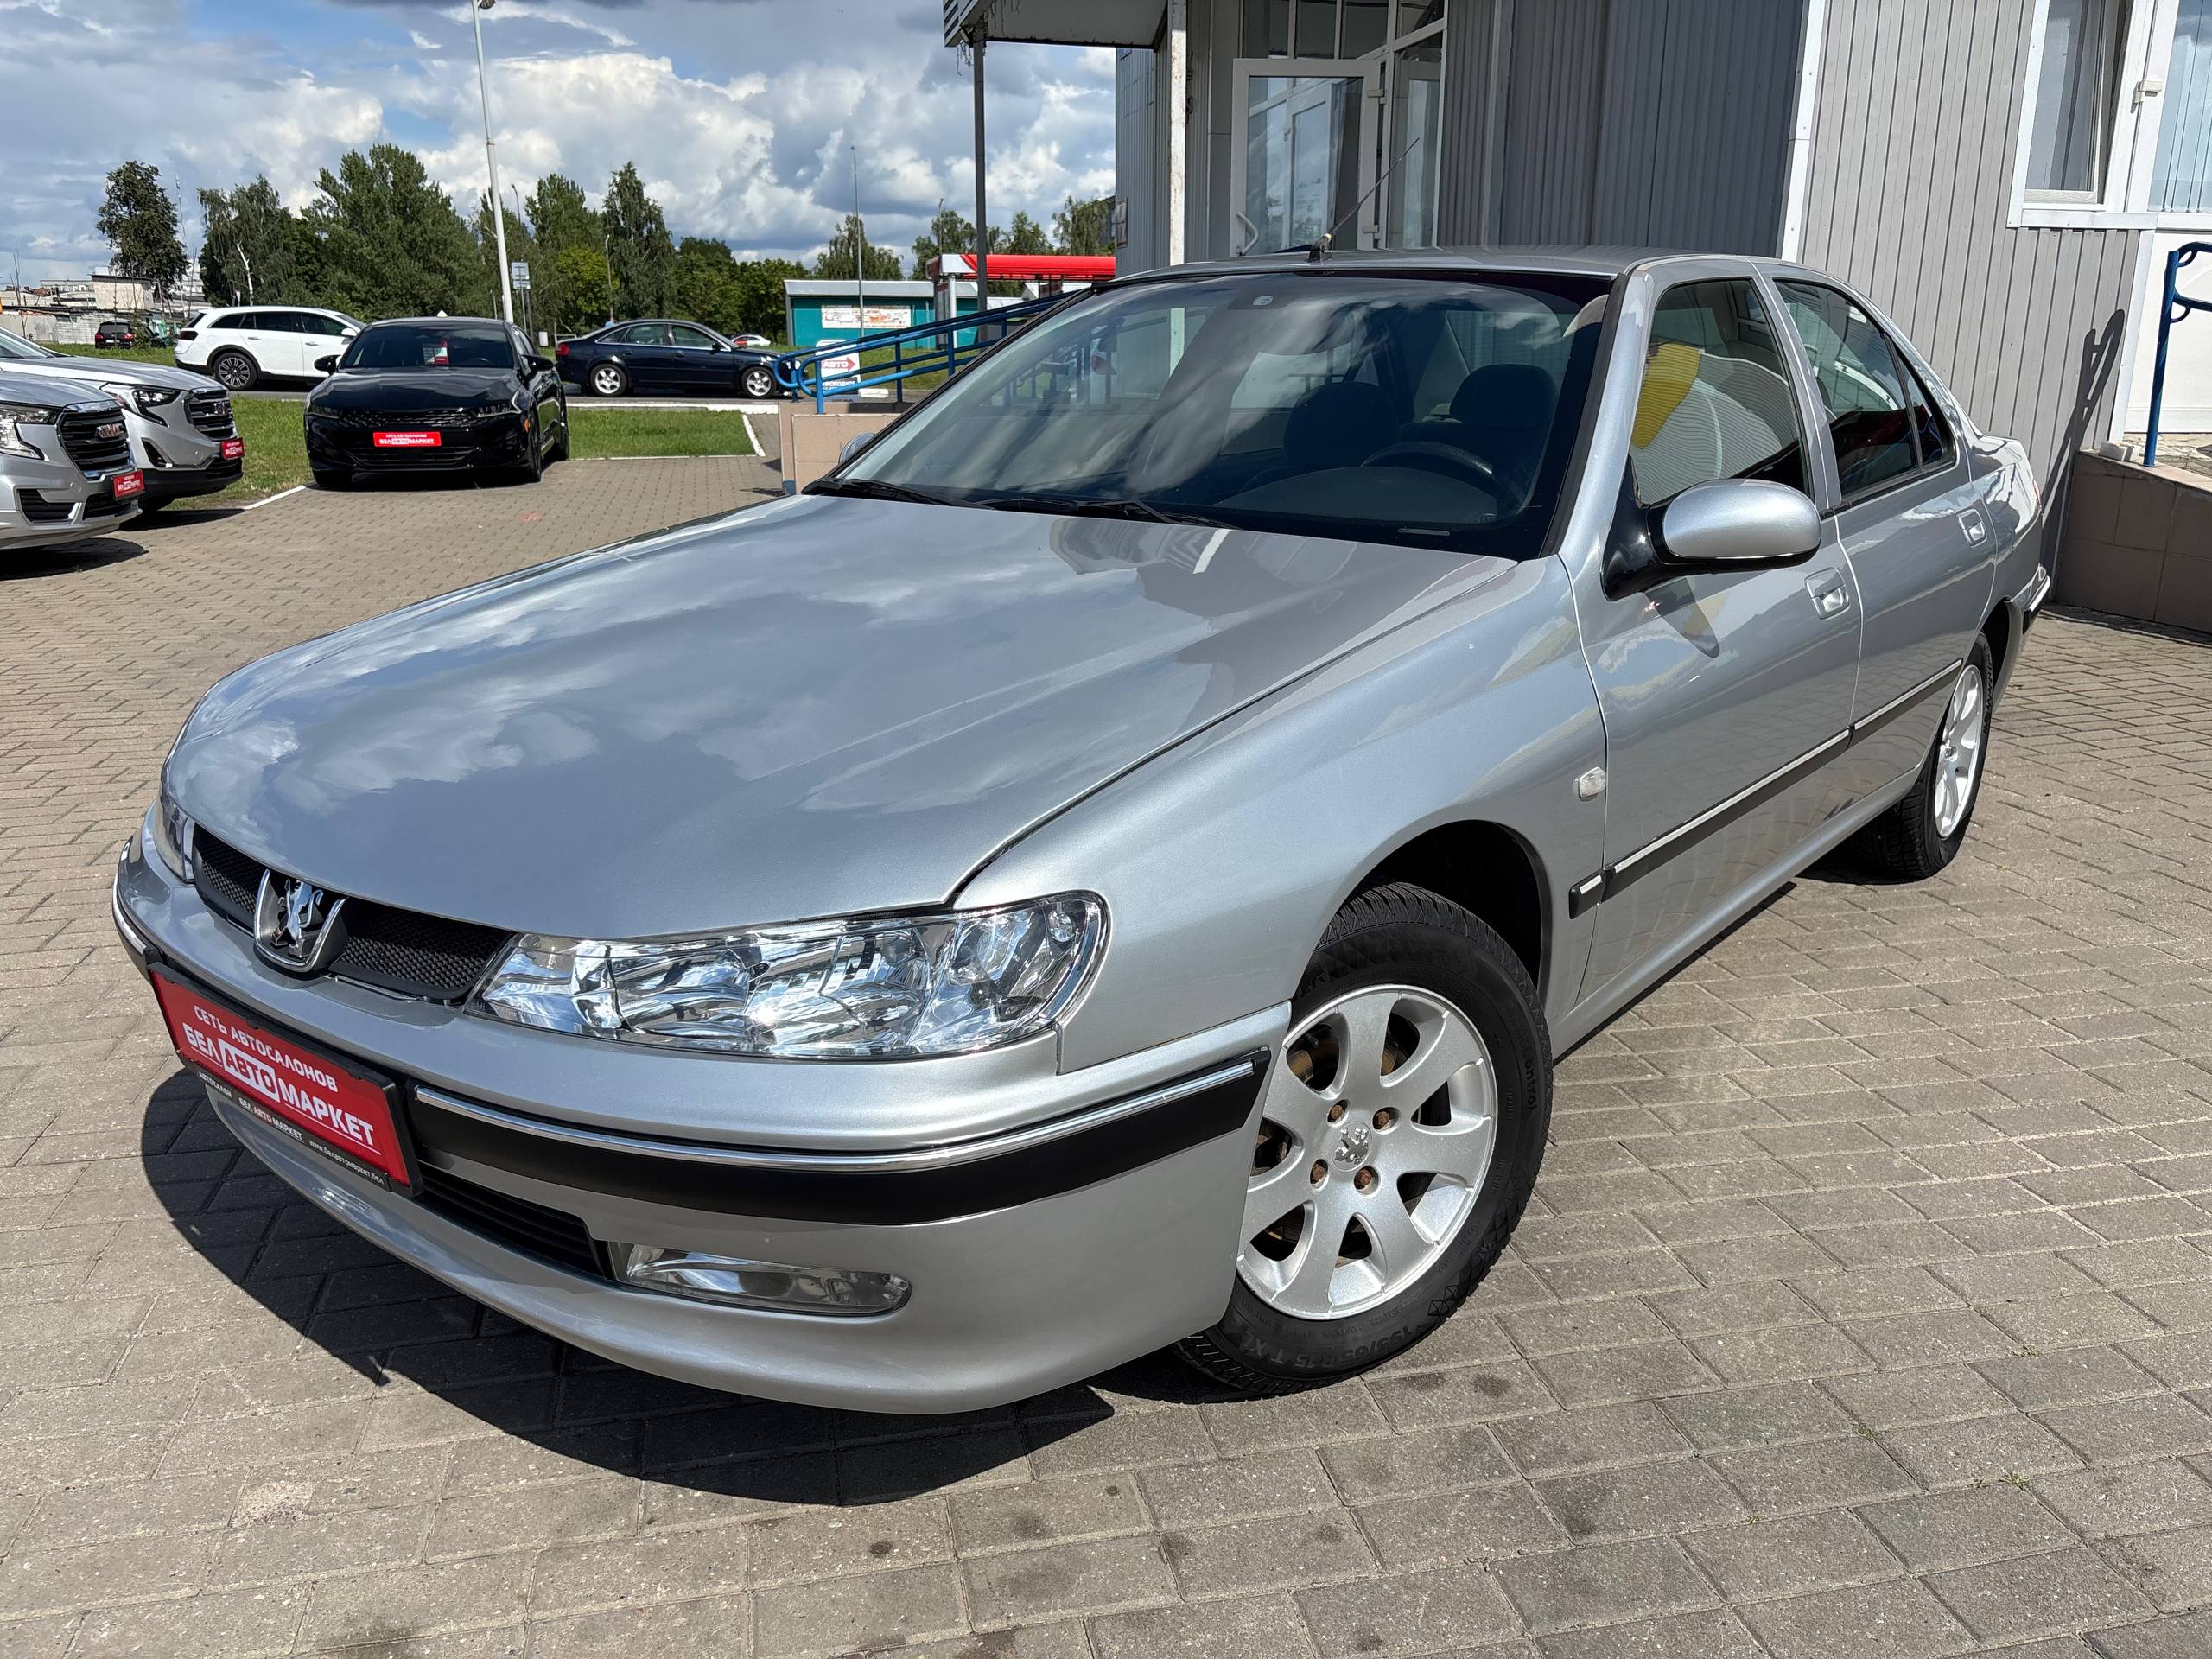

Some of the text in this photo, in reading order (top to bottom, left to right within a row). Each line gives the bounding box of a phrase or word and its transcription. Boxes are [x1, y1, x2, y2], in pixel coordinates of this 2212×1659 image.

[99, 423, 124, 439] GMC
[194, 1005, 339, 1093] СЕТЬ АВТОСАЛОНОВ
